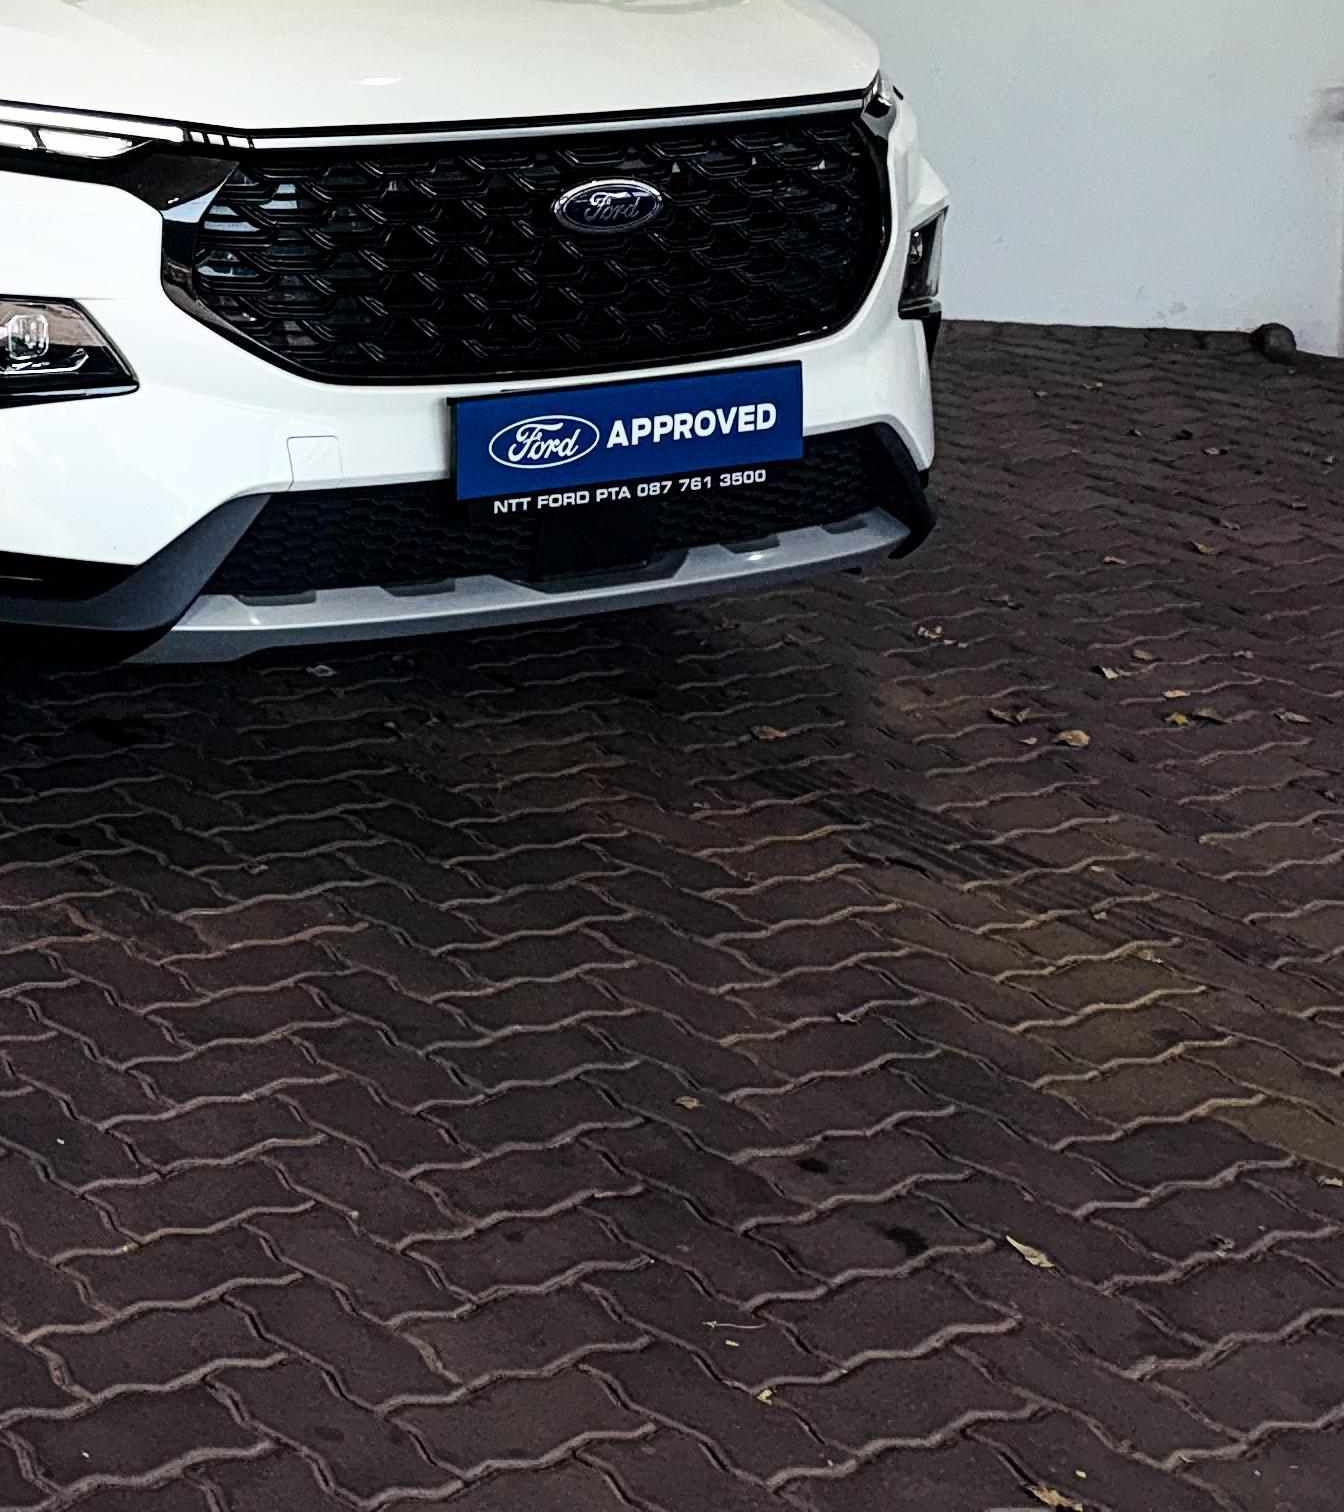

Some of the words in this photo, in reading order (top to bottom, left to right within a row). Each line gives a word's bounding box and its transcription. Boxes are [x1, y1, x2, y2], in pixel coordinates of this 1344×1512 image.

[583, 191, 642, 222] Ford
[508, 423, 580, 461] Ford
[607, 403, 777, 449] APPROVED
[493, 497, 532, 514] NTT
[537, 490, 590, 509] FORD
[596, 486, 631, 502] PTA
[636, 481, 673, 497] 087
[678, 475, 712, 492] 761
[719, 469, 767, 487] 3500
